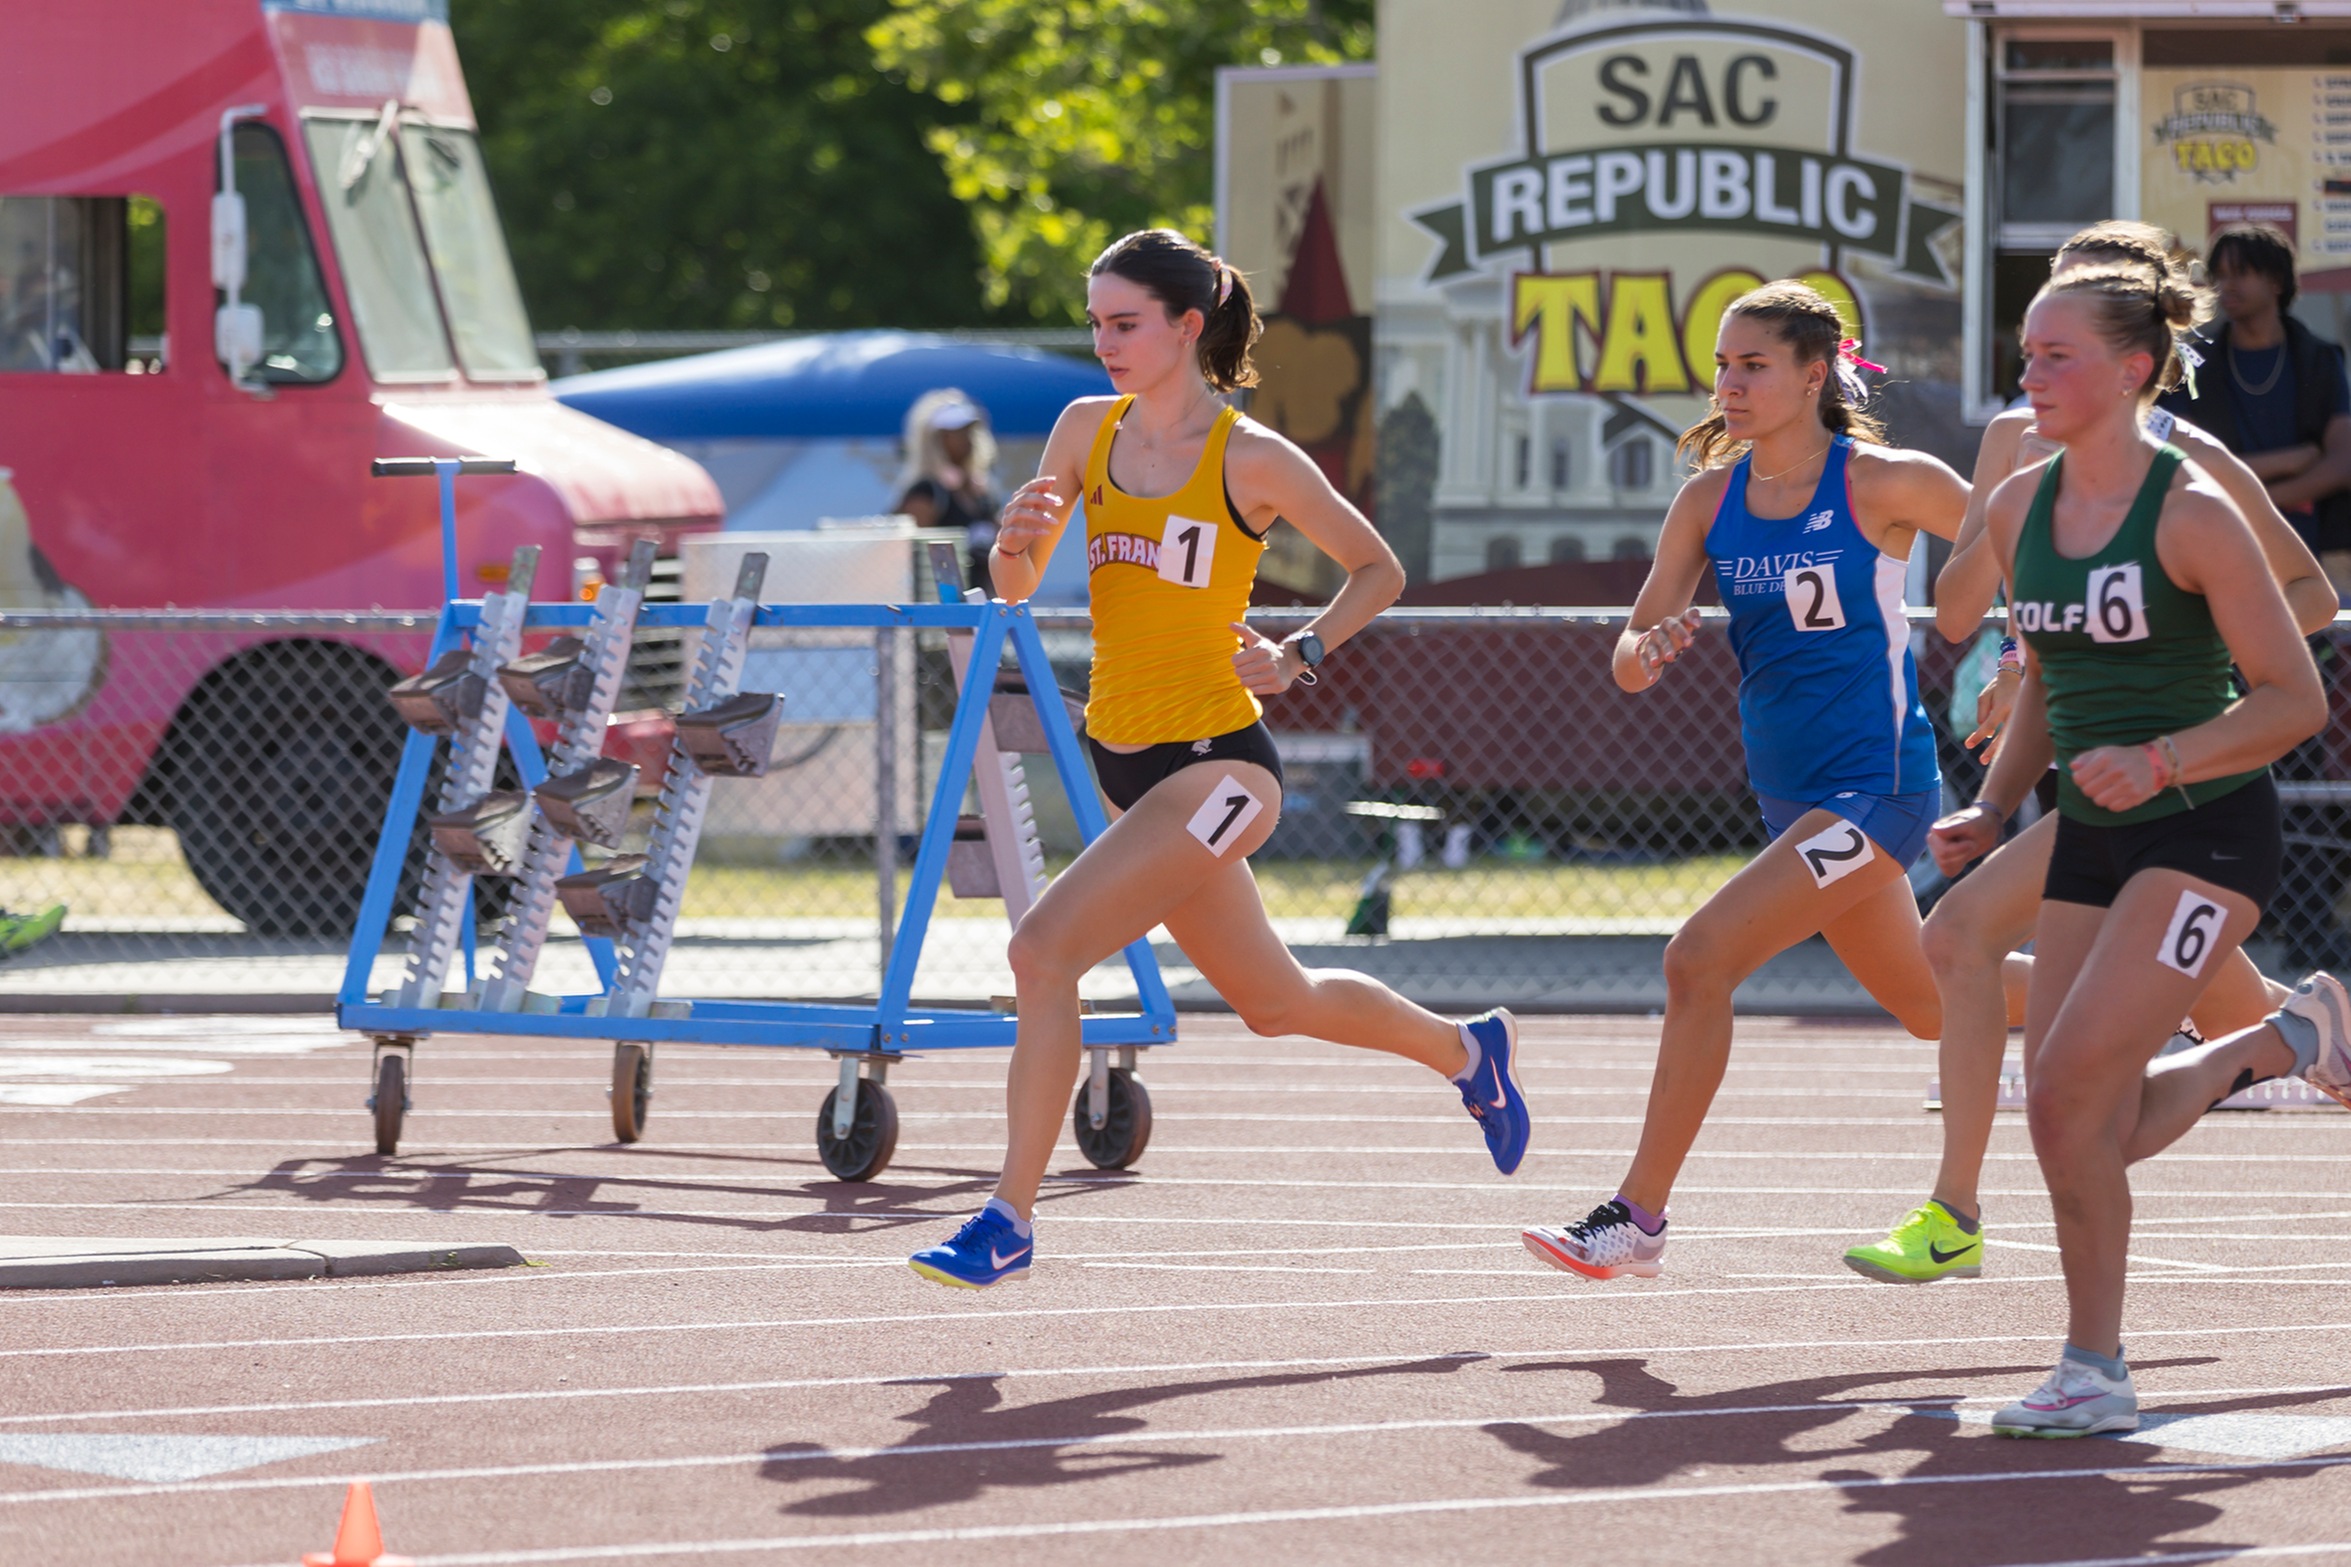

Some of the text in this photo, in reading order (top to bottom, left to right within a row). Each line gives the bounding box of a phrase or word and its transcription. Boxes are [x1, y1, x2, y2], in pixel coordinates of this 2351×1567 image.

[1596, 52, 1780, 129] SAC
[2174, 141, 2257, 172] TACO
[1491, 148, 1878, 243] REPUBLIC
[1178, 526, 1201, 583] 1
[1733, 550, 1814, 579] DAVIS
[1733, 582, 1766, 596] BLUE
[1796, 571, 1835, 628] 2
[2099, 571, 2143, 639] 6
[1207, 795, 1250, 847] 1
[1804, 828, 1864, 878] 2
[2175, 904, 2217, 969] 6
